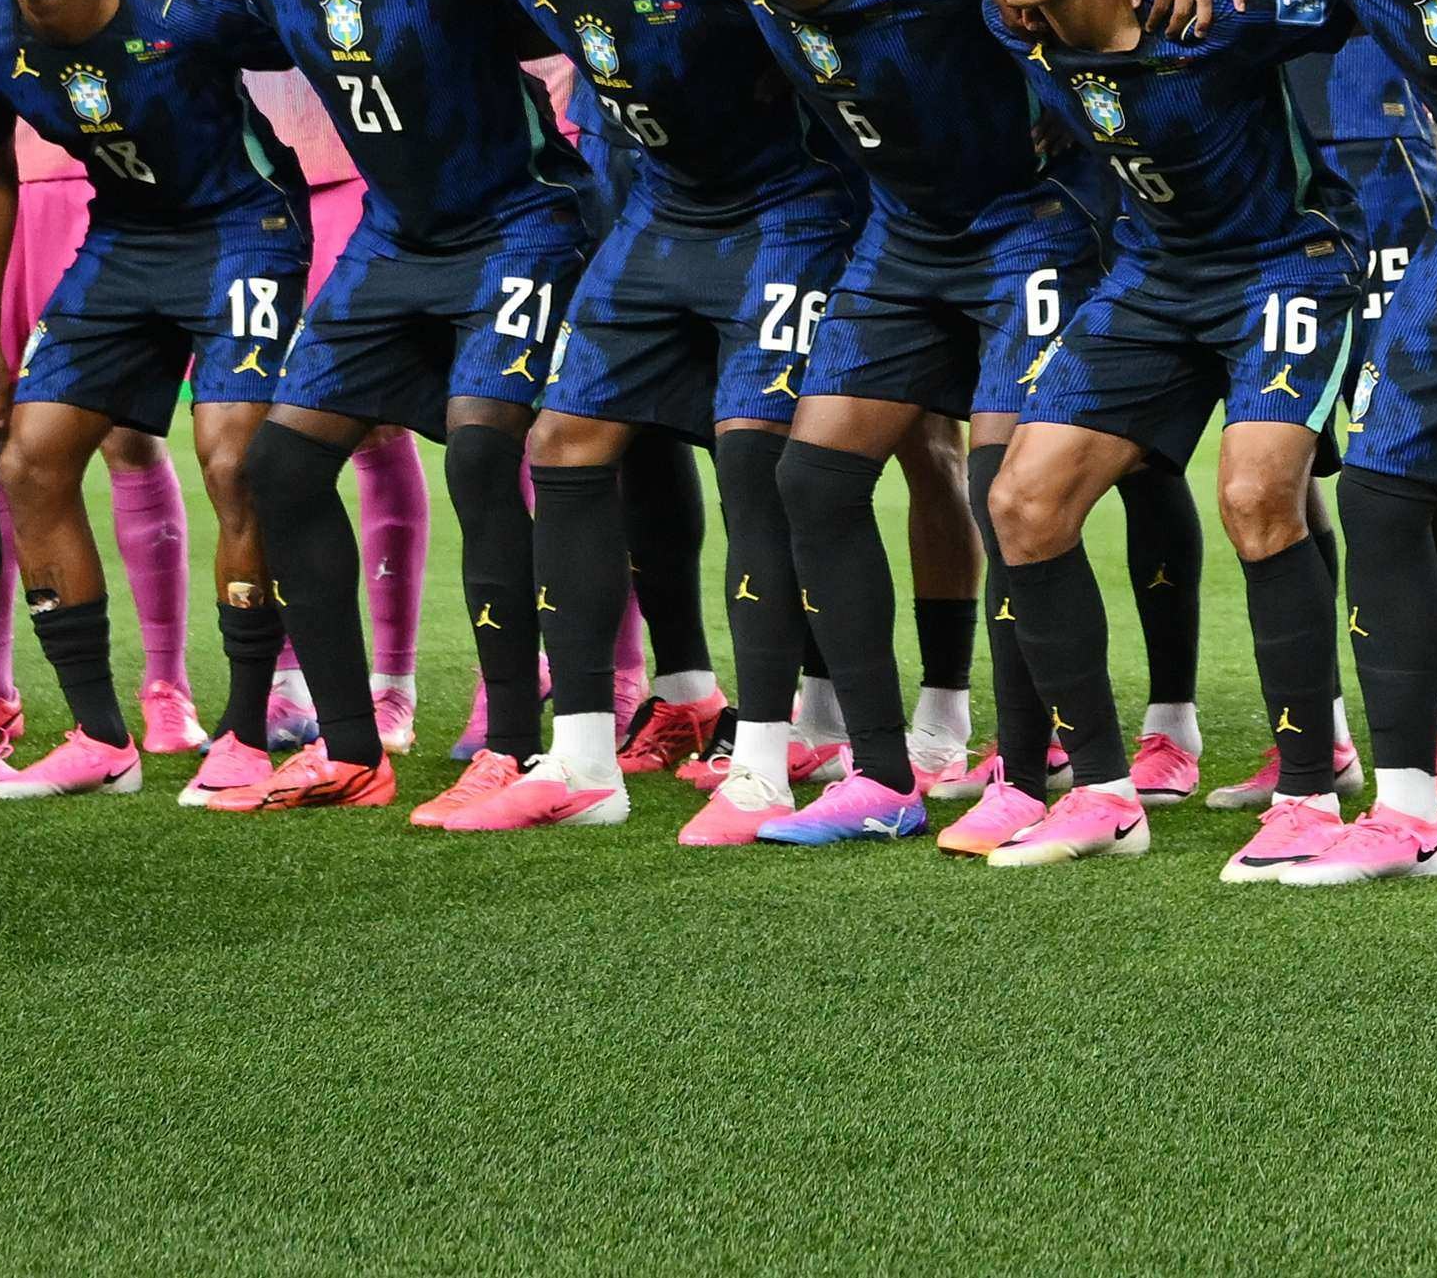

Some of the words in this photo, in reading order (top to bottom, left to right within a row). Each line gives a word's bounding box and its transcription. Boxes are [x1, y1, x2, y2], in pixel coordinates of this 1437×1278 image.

[331, 49, 372, 62] BRASIL
[336, 75, 403, 133] 21
[837, 100, 882, 148] 6
[1109, 155, 1175, 203] 16
[228, 277, 280, 341] 18
[495, 276, 552, 343] 21
[1025, 268, 1059, 337] 6
[1262, 293, 1318, 355] 16
